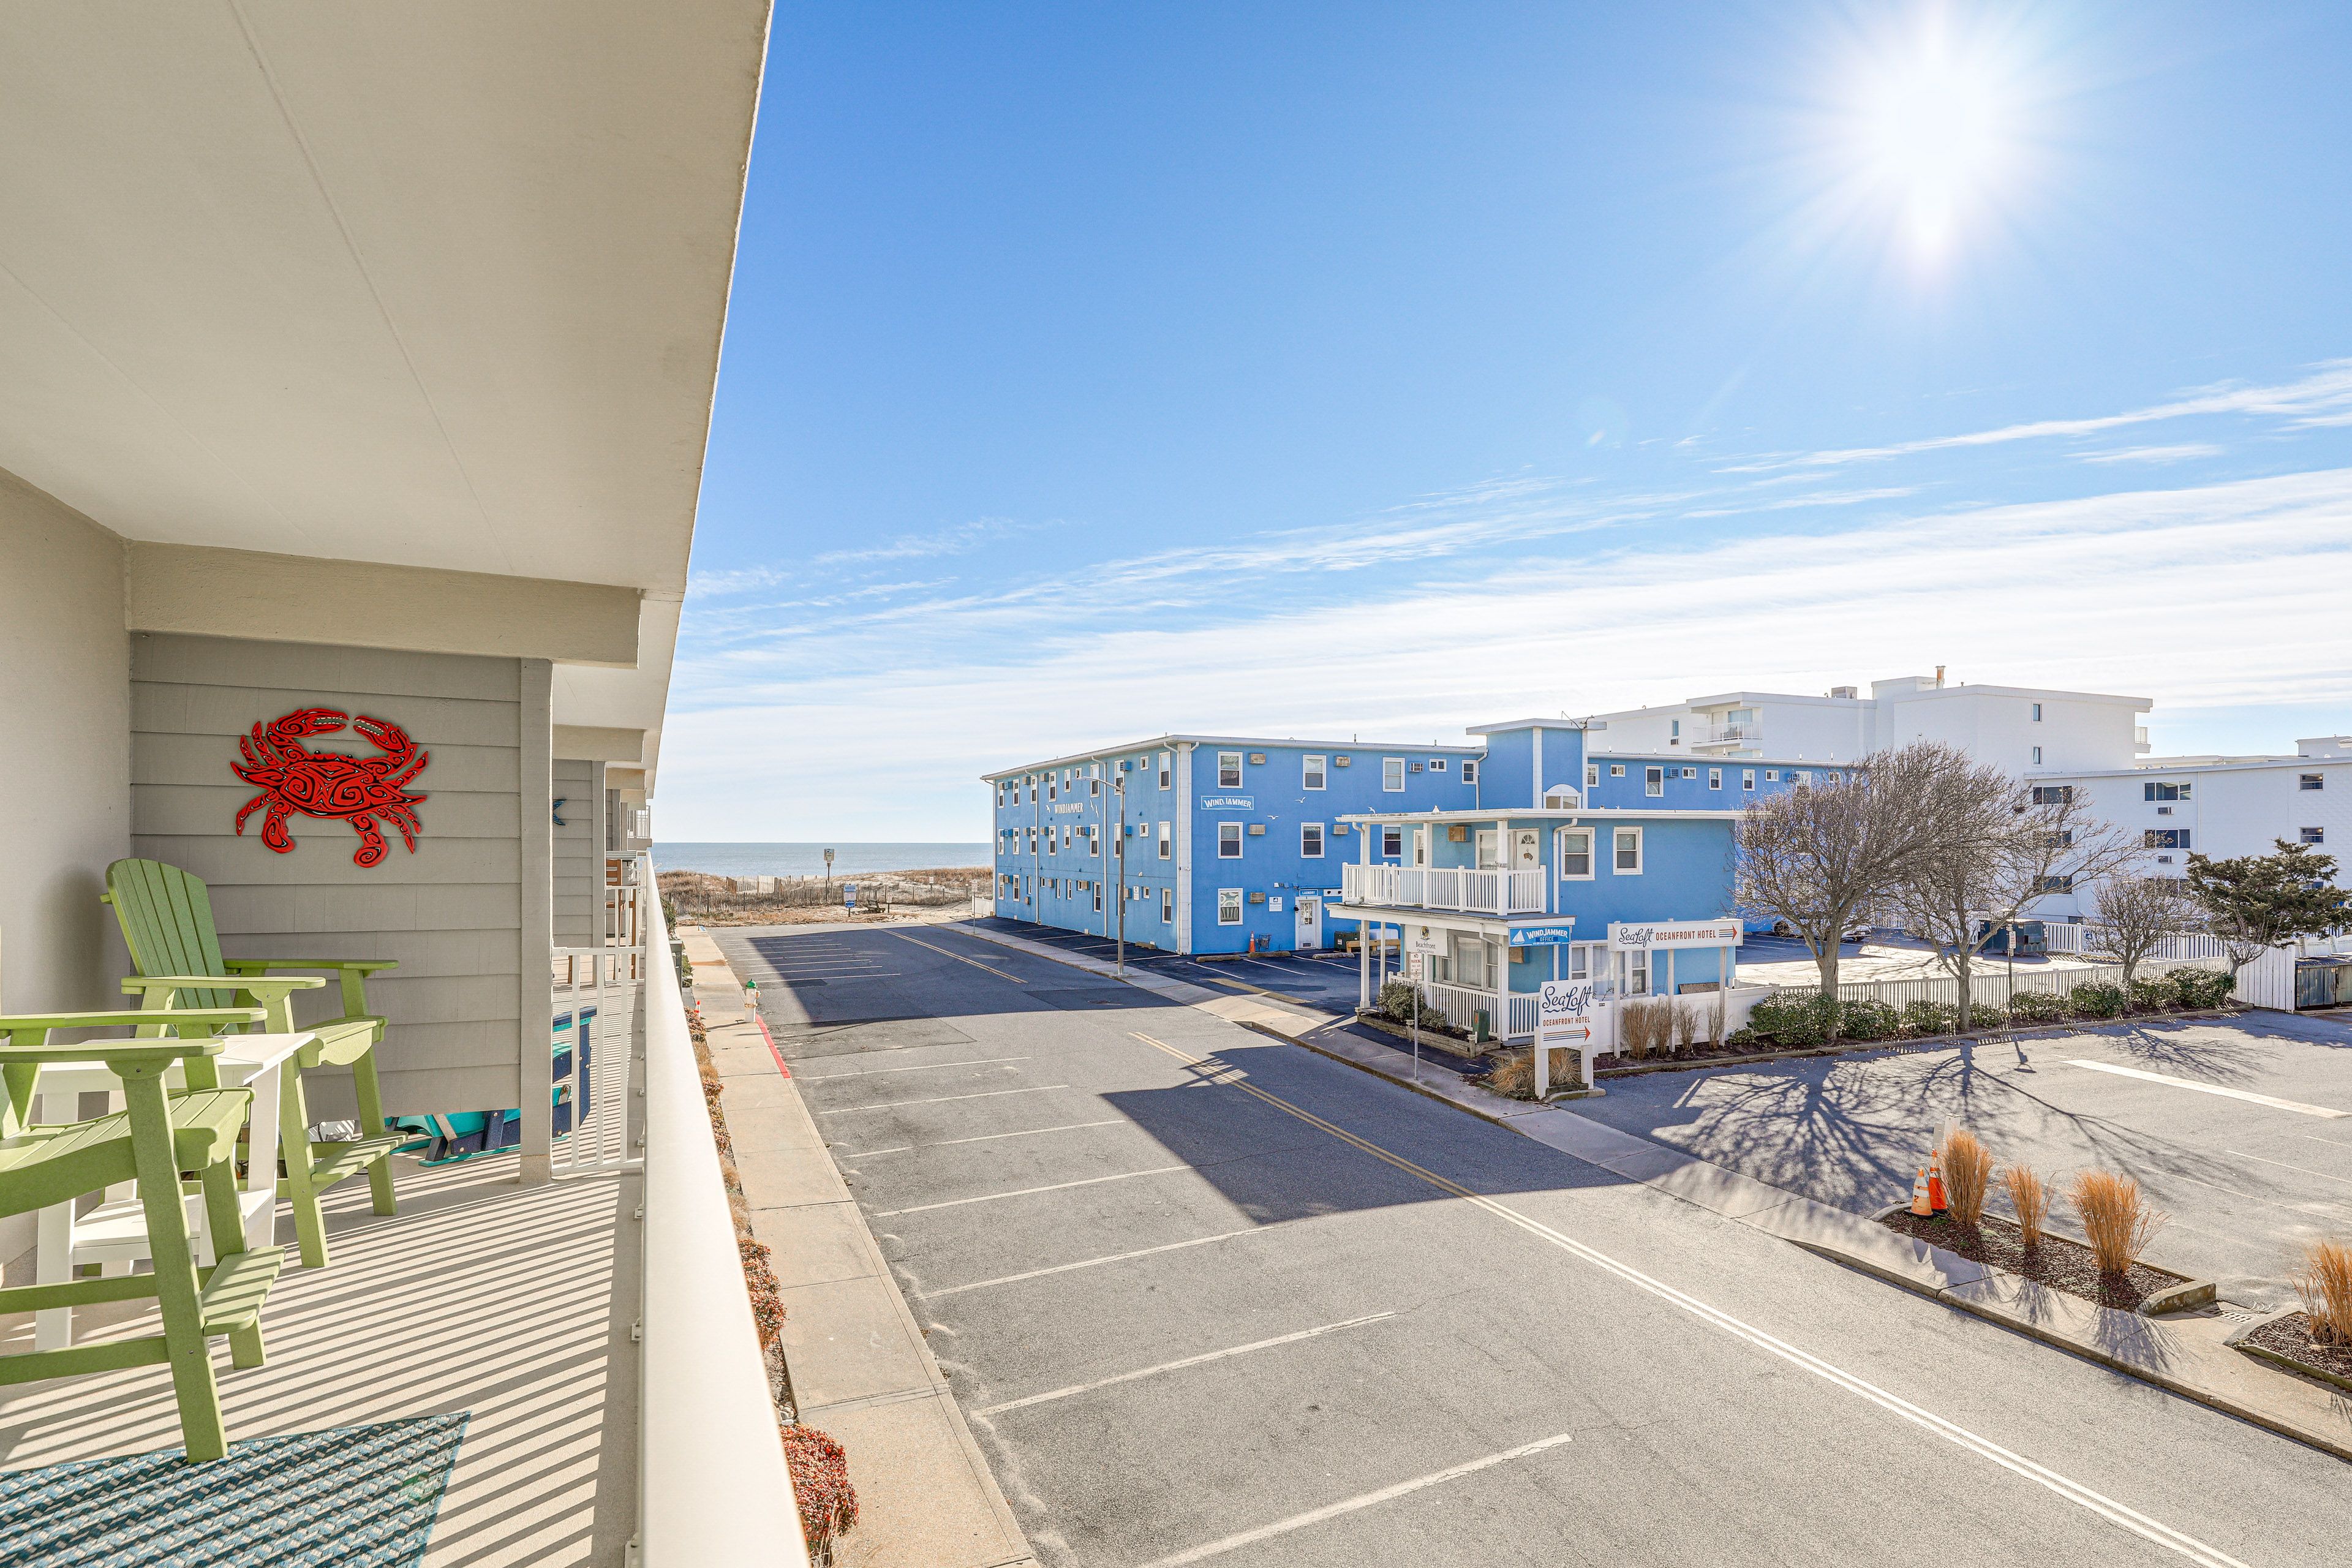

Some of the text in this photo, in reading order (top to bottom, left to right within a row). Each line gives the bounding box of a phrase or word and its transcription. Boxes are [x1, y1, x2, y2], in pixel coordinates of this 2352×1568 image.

[1055, 802, 1083, 813] WINDJAMMER
[1526, 929, 1567, 939] WINDJAMMER
[1656, 931, 1695, 941] OCEANFRONT
[1697, 930, 1716, 938] HOTEL
[1544, 1018, 1574, 1027] OCEANFRONT
